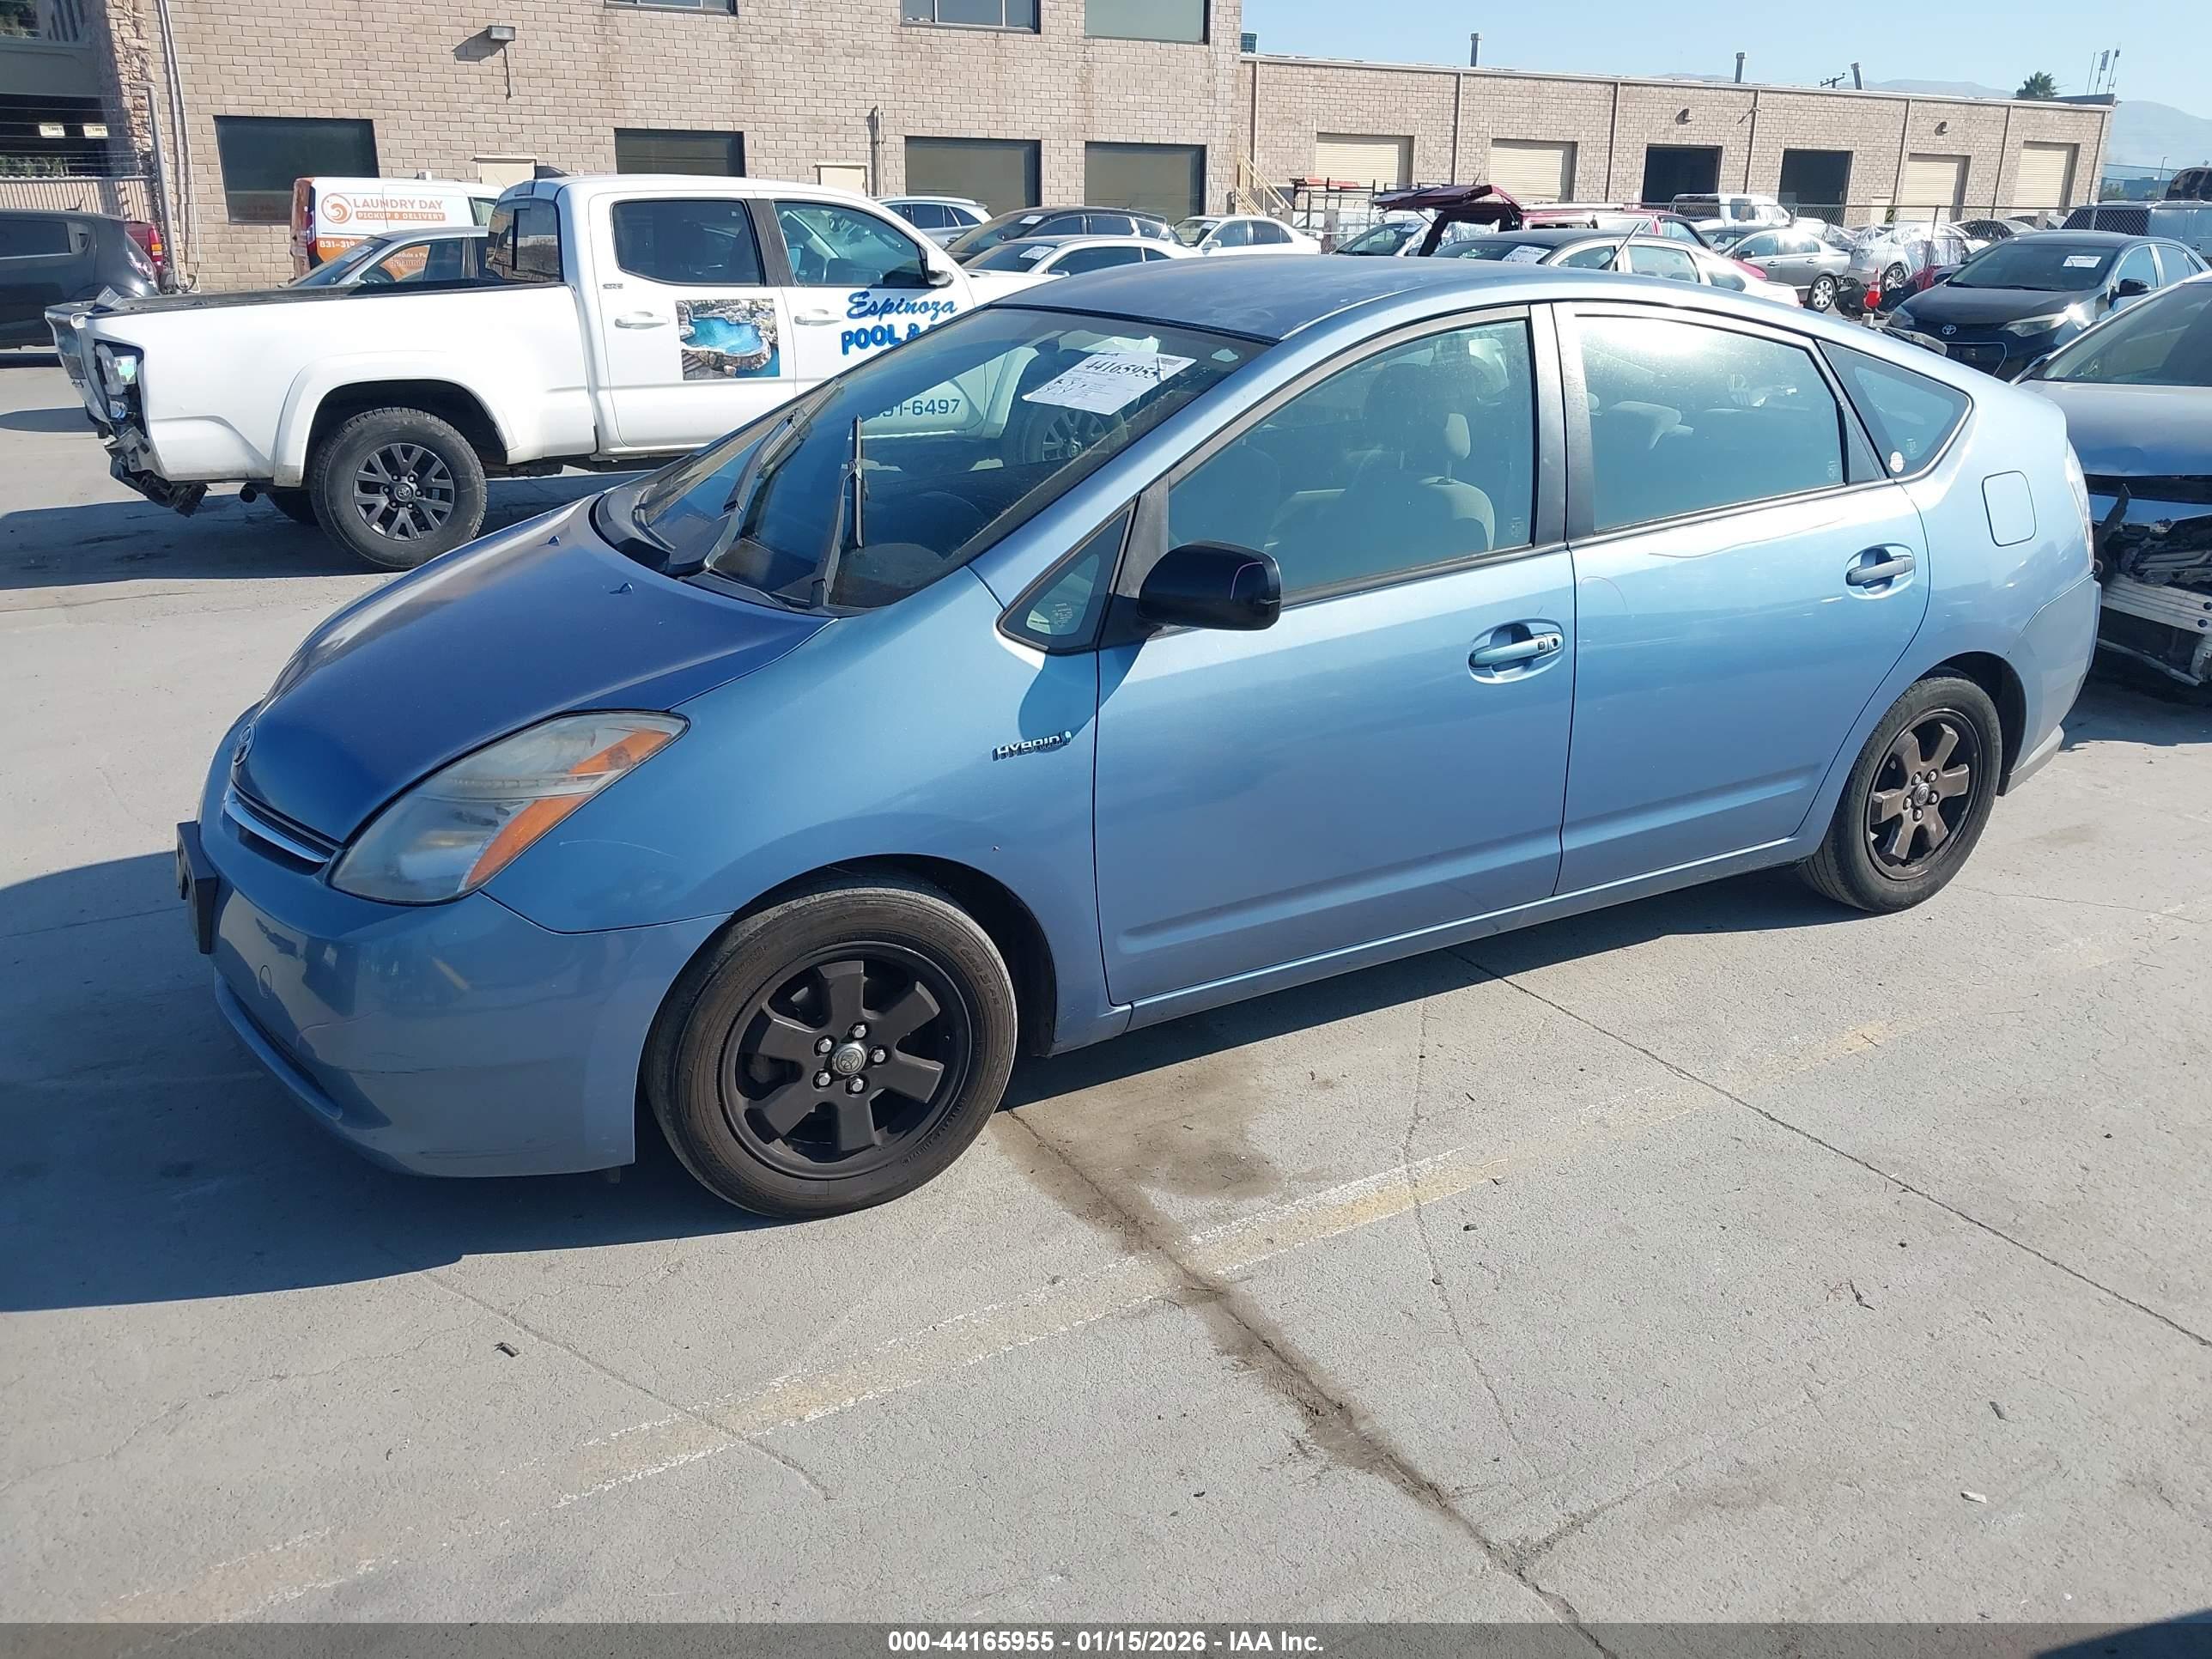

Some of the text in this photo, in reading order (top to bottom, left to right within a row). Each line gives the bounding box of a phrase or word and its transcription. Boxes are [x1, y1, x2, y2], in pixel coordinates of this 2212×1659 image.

[353, 198, 443, 210] LAUNDRY DAY
[1885, 210, 1894, 222] 2
[847, 290, 958, 322] Espinoza
[841, 324, 902, 356] POOL
